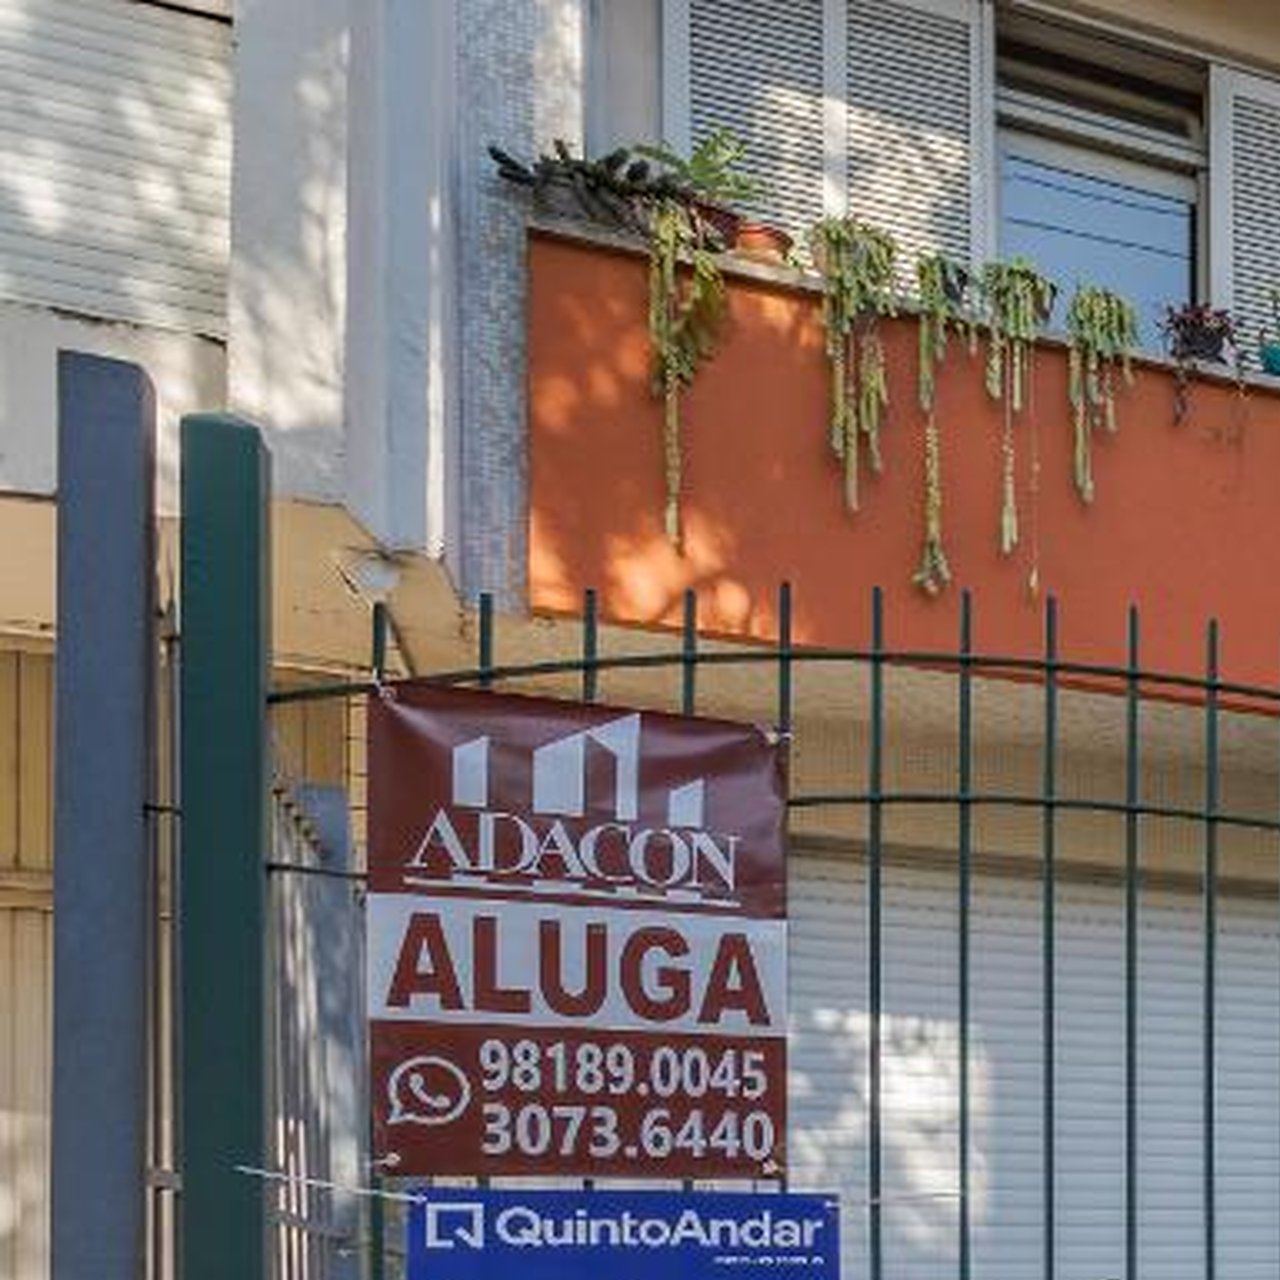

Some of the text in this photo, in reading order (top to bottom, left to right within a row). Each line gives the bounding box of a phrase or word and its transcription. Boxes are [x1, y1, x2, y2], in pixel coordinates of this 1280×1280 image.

[403, 807, 741, 893] ADACON
[386, 911, 772, 1026] ALUGA
[478, 1038, 768, 1100] 98189.0045
[481, 1102, 776, 1160] 3073.6440
[496, 1206, 824, 1248] QuintoAndar
